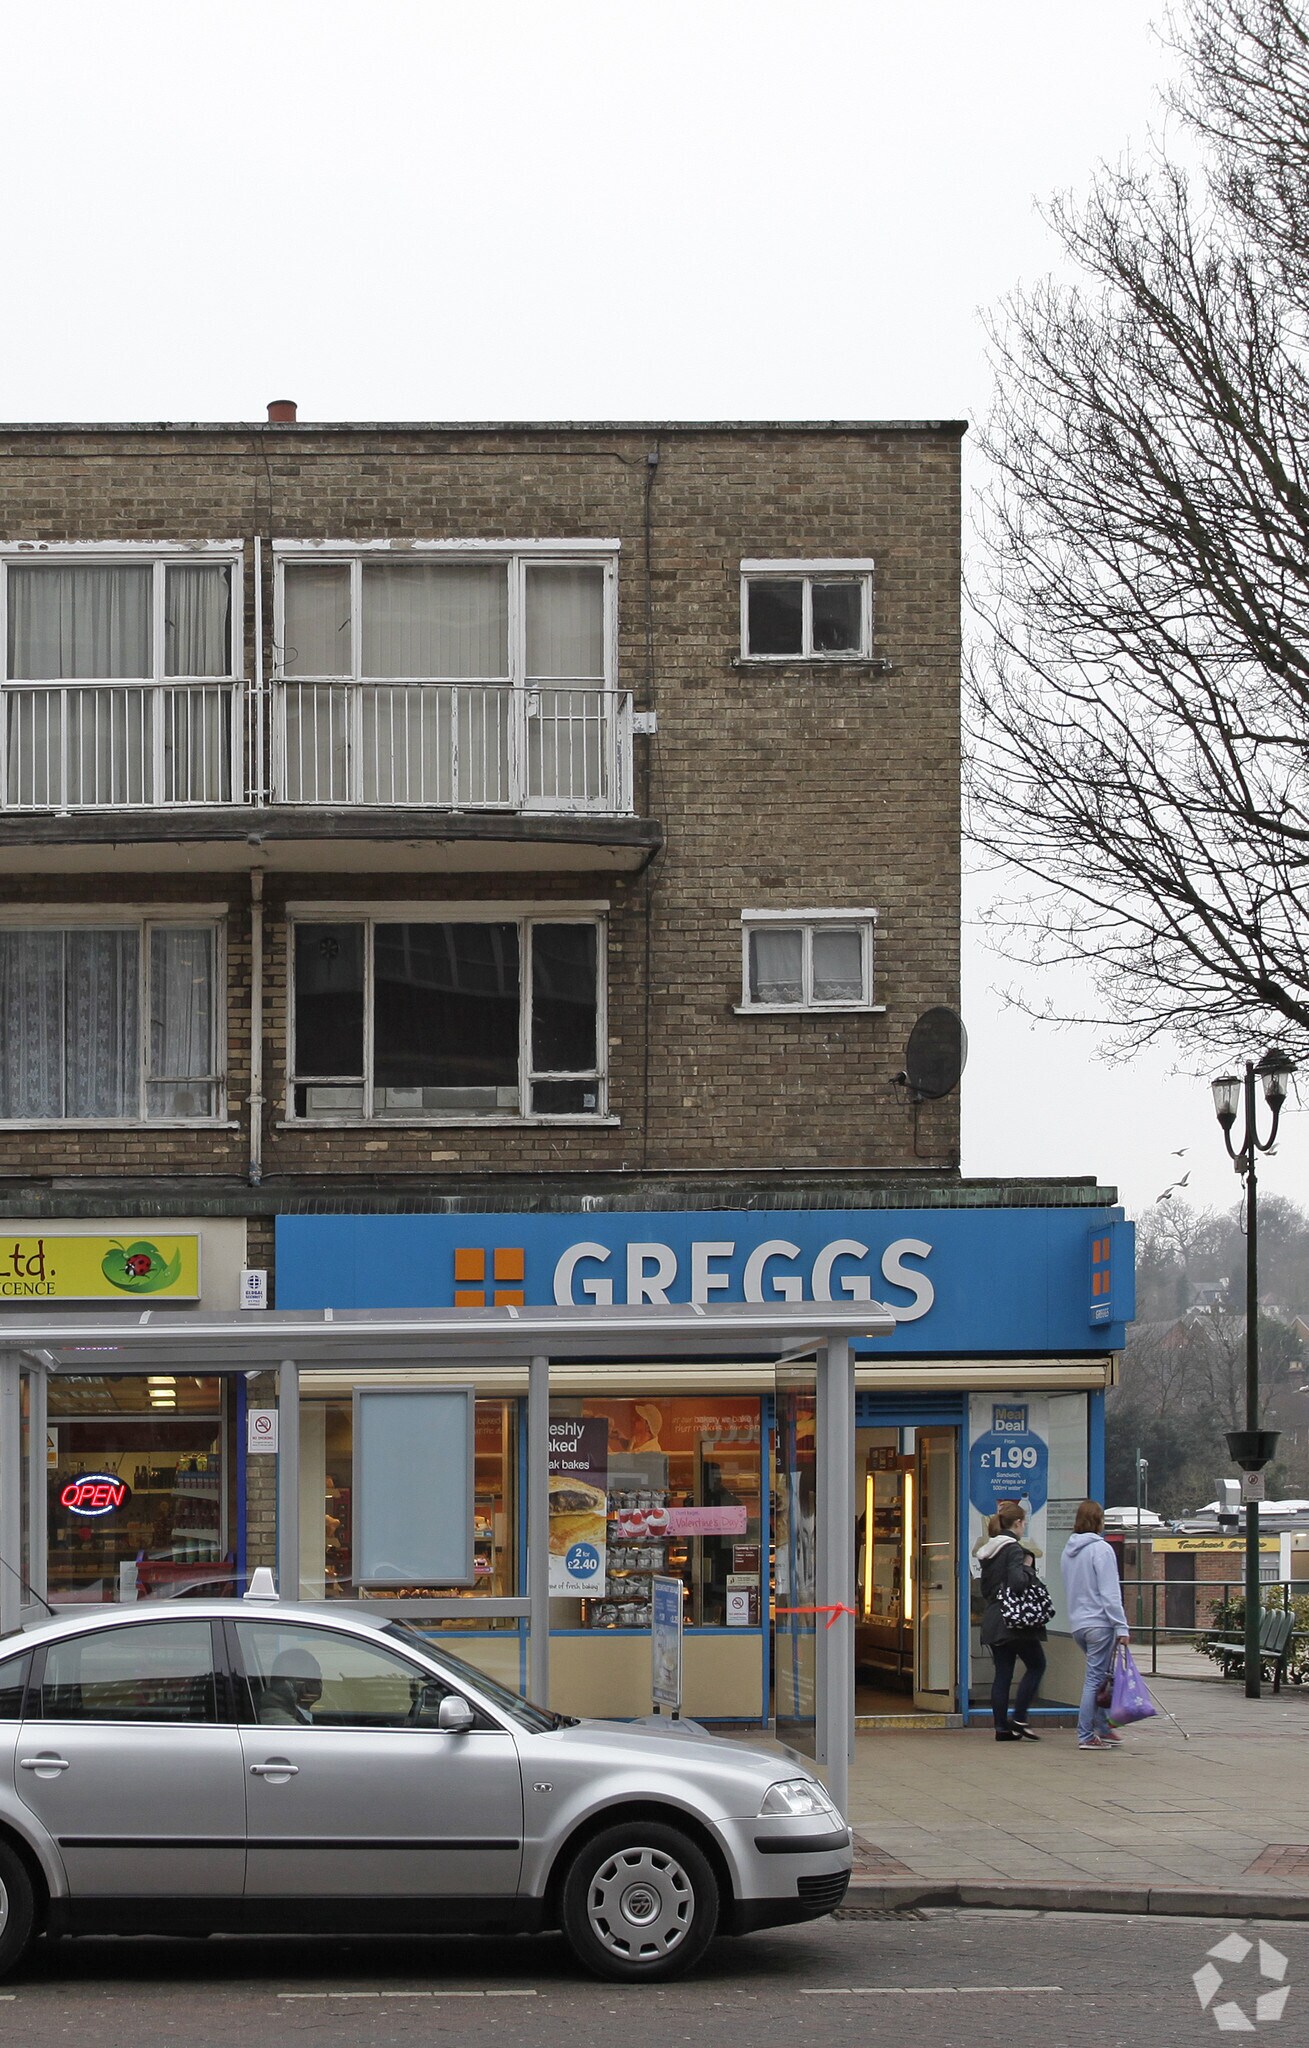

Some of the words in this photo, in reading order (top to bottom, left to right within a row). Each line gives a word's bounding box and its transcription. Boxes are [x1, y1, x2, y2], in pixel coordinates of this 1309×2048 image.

[0, 1239, 56, 1281] td.
[553, 1238, 935, 1322] GREGGS
[0, 1282, 56, 1295] CENCE
[995, 1408, 1025, 1419] Meal
[549, 1422, 585, 1439] eshly
[995, 1419, 1025, 1431] Deal
[562, 1459, 590, 1469] bakes
[980, 1447, 1037, 1469] £1.99
[60, 1484, 127, 1507] OPEN
[676, 1517, 719, 1529] Valentine's
[721, 1516, 739, 1529] Day
[575, 1548, 582, 1557] 2
[567, 1559, 598, 1570] £2.40
